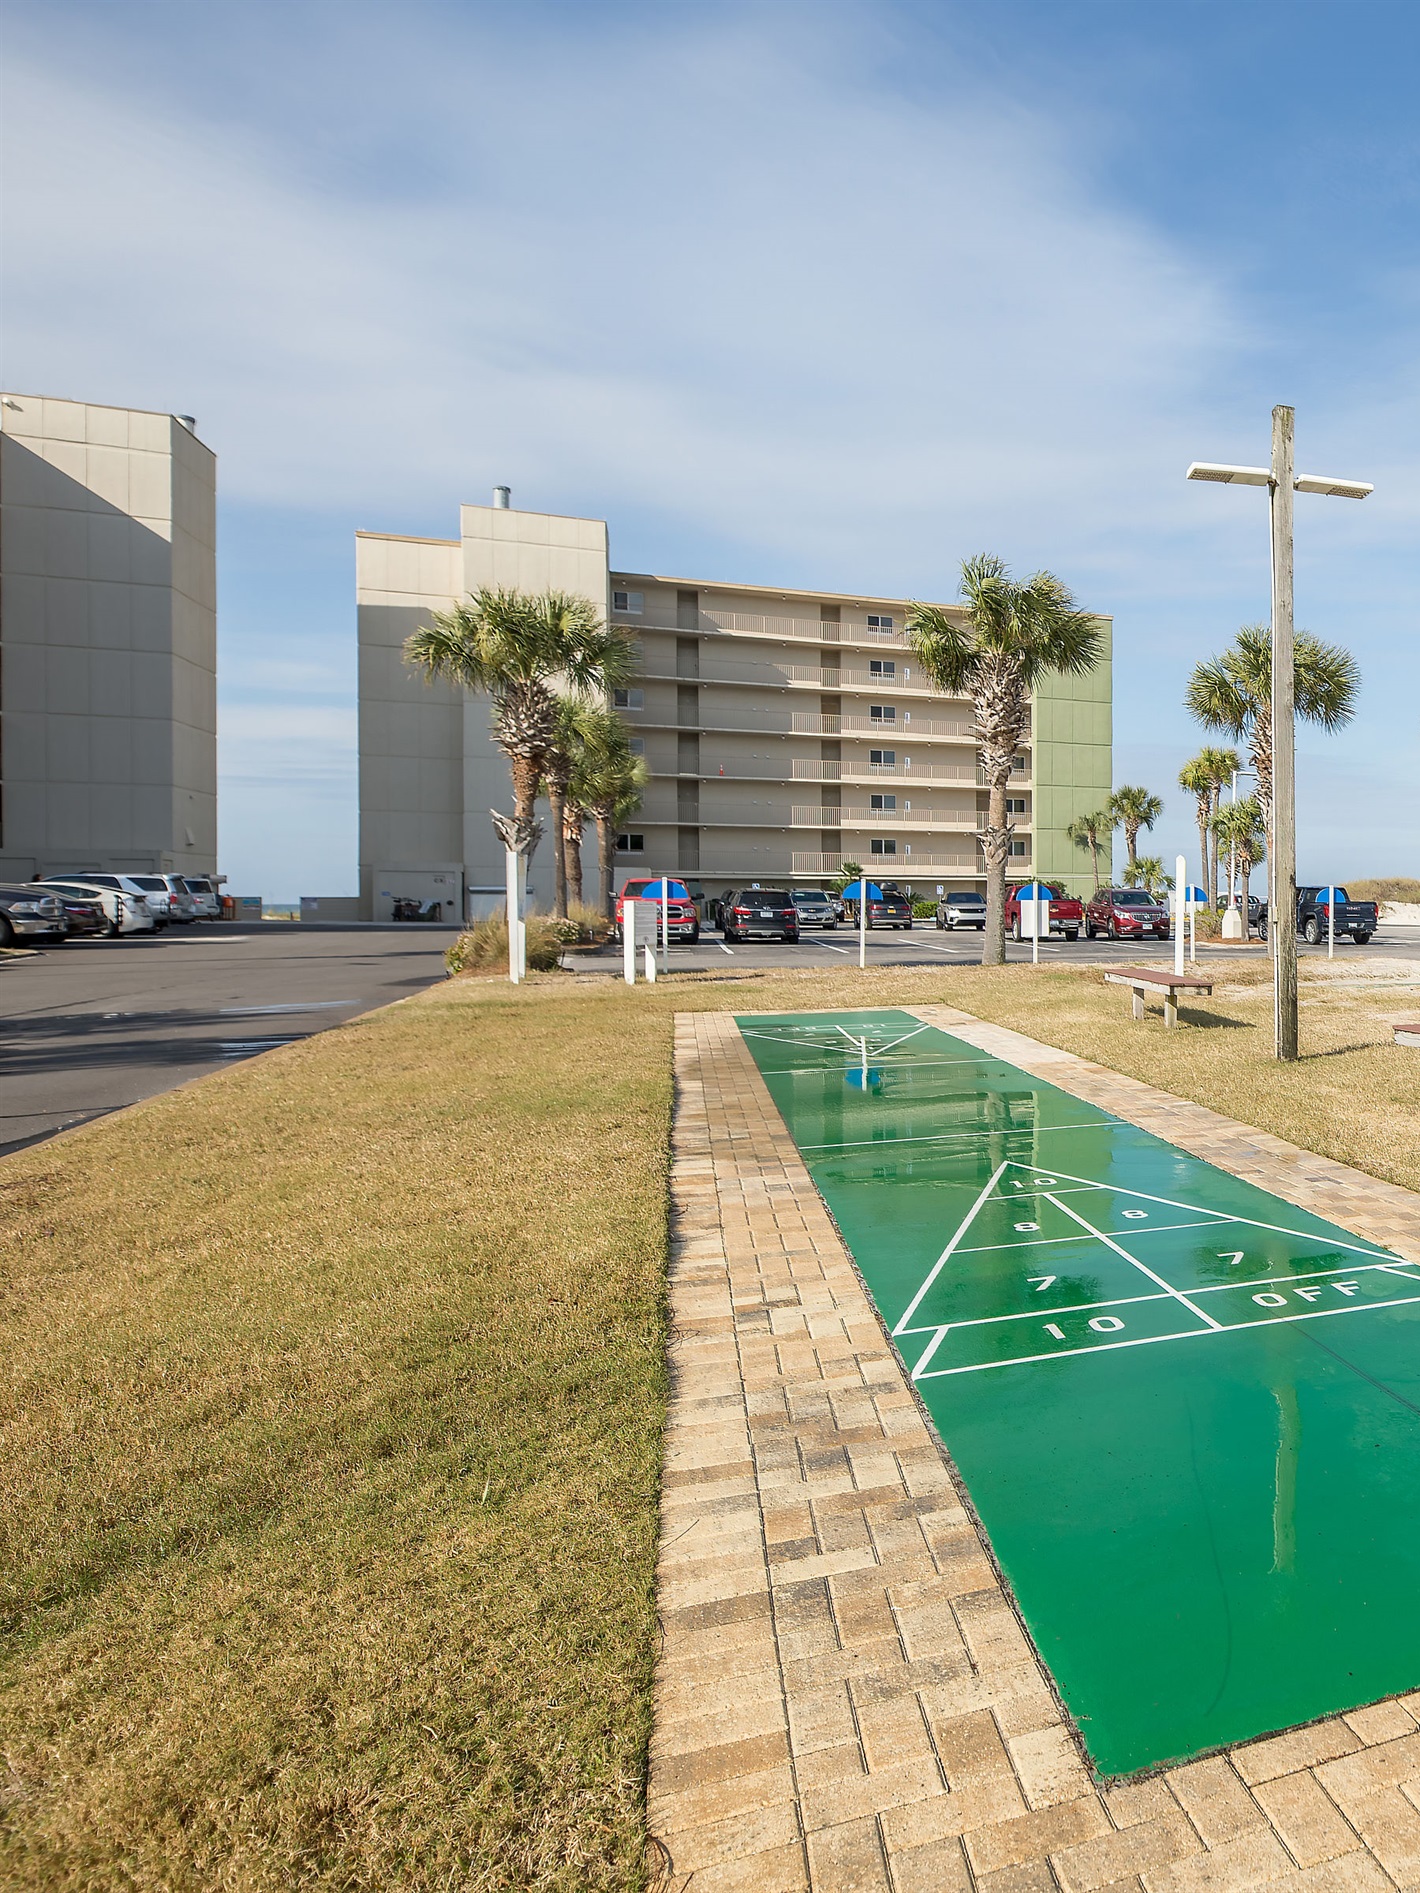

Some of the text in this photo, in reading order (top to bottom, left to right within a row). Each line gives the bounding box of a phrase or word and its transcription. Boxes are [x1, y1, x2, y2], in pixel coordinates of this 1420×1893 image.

[1009, 1177, 1058, 1189] 10
[1121, 1209, 1149, 1219] 8
[1013, 1222, 1041, 1232] 8
[1217, 1251, 1245, 1265] 7
[1027, 1275, 1057, 1292] 7
[1042, 1280, 1360, 1340] 10 OFF
